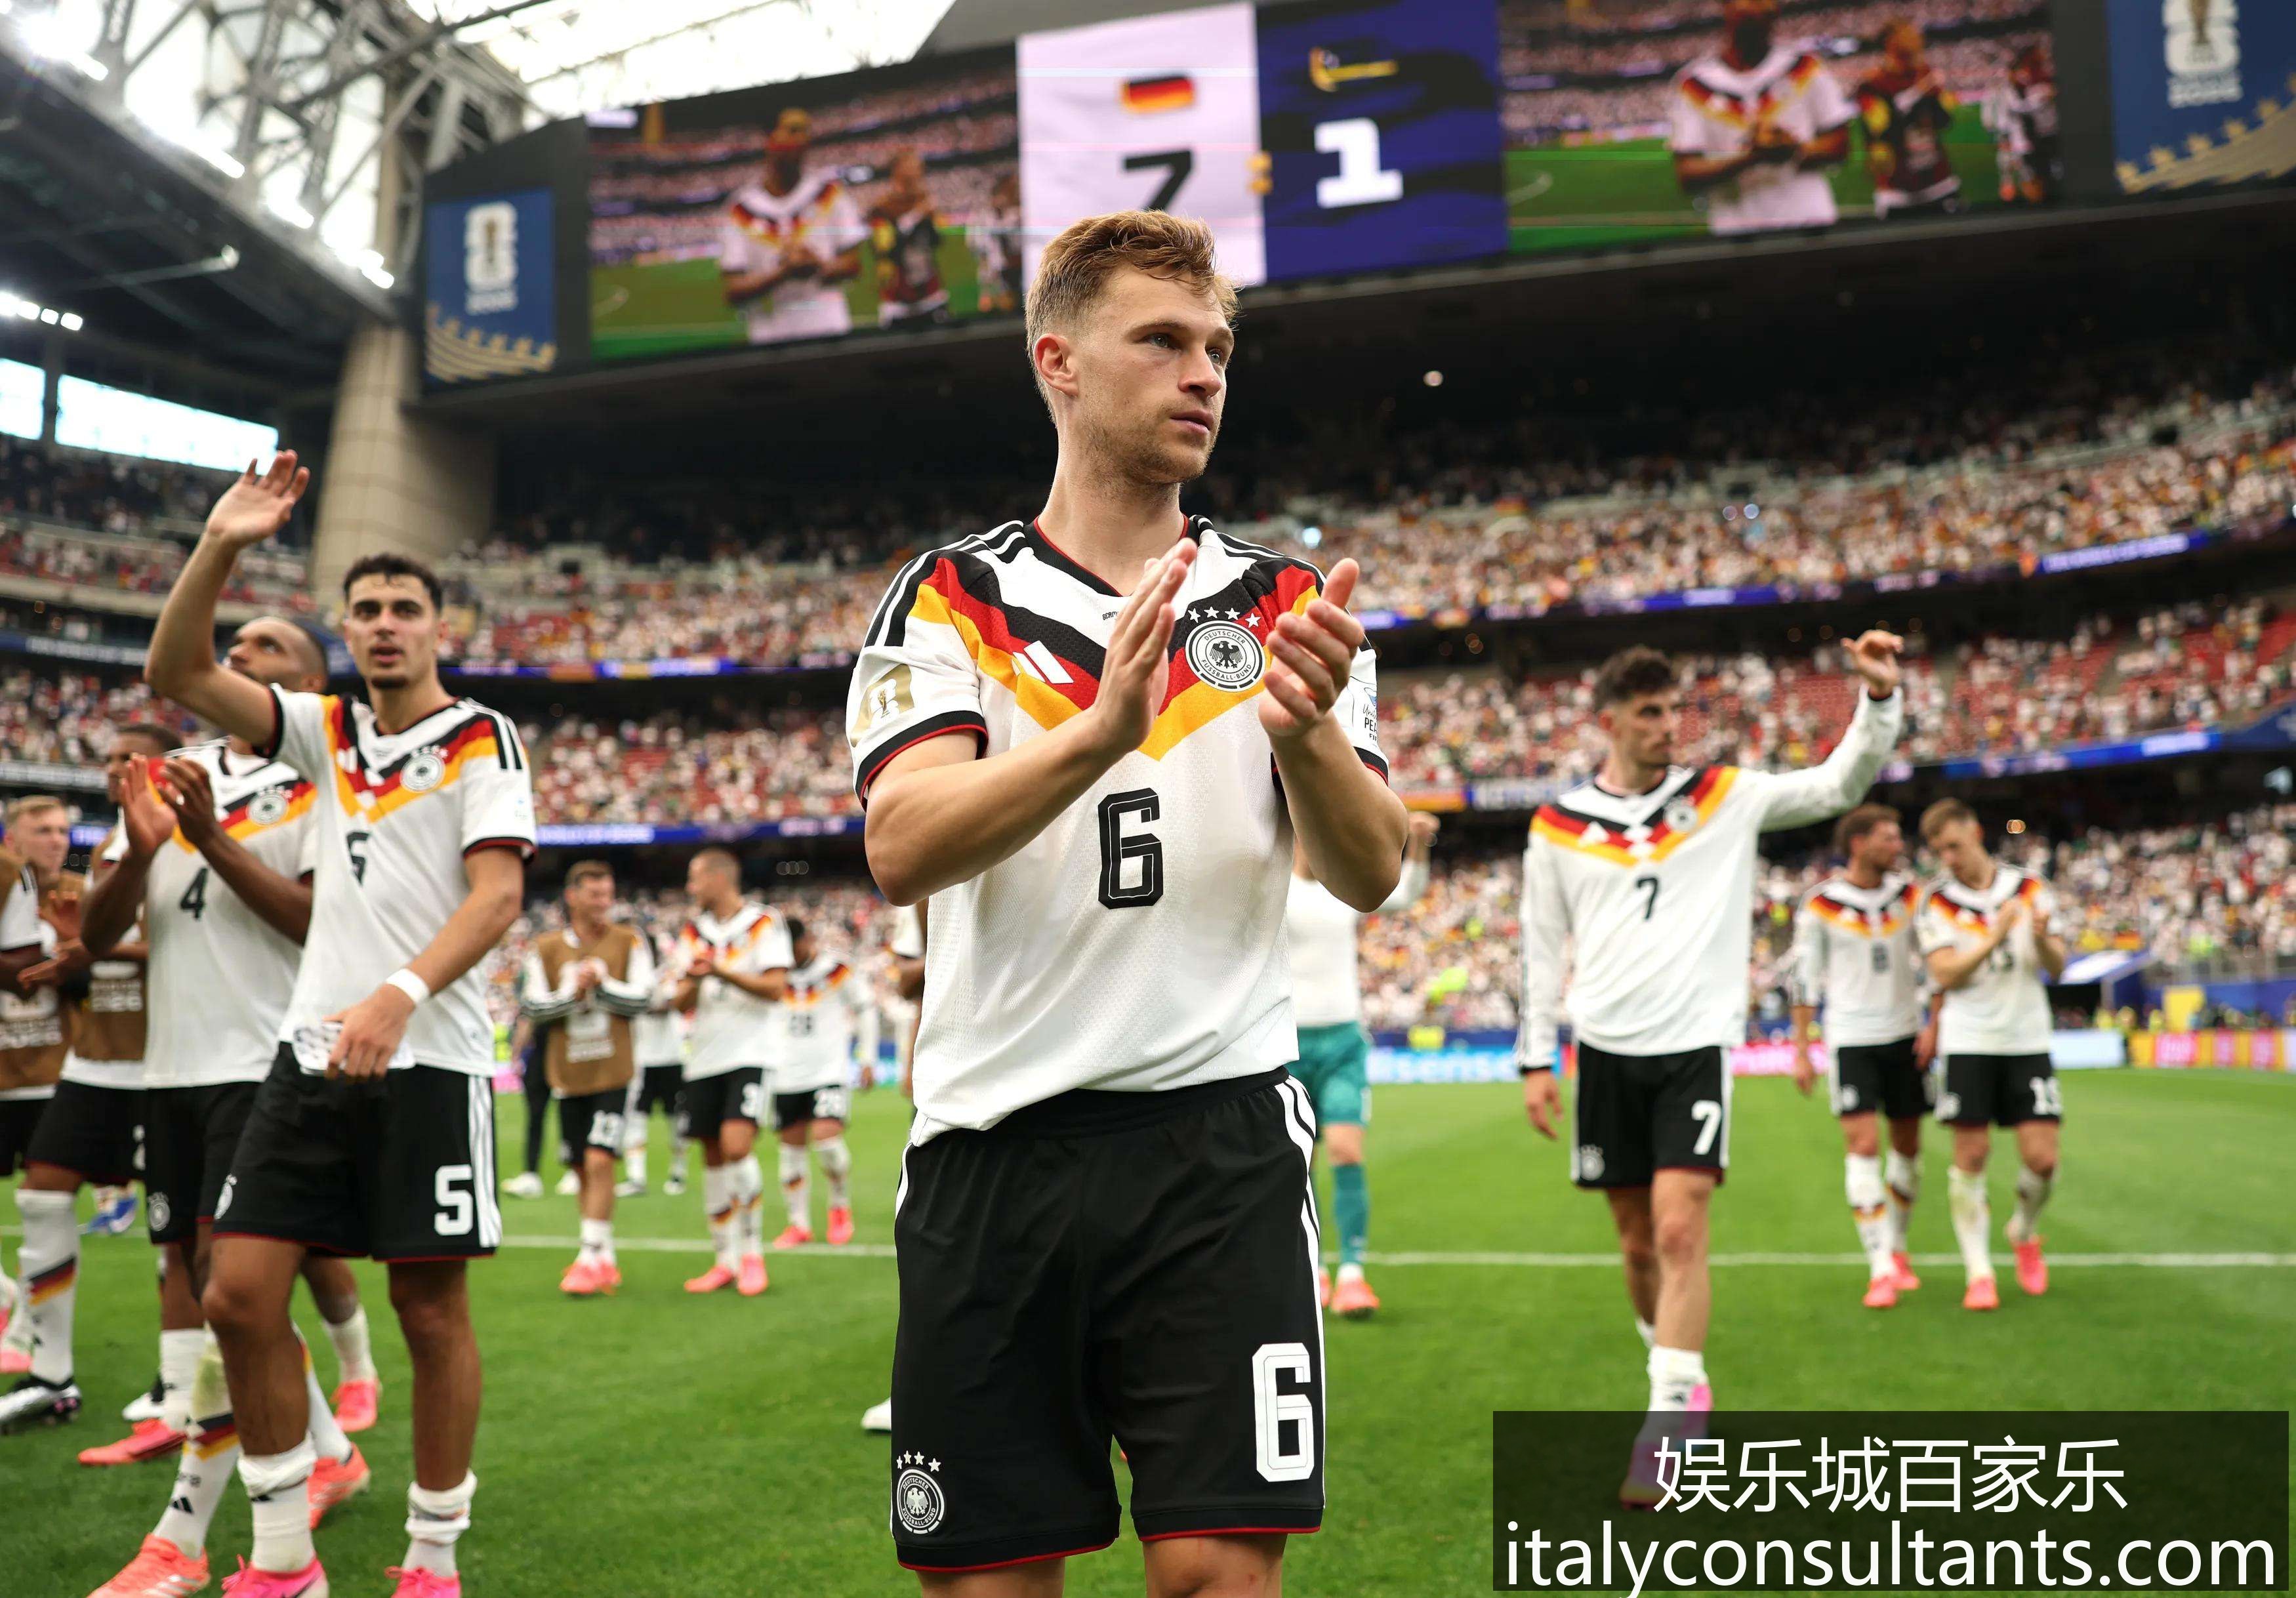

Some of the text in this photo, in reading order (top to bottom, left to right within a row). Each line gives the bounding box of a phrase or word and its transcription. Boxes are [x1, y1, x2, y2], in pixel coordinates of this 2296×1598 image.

[1123, 150, 1194, 211] 7
[1315, 117, 1403, 209] 1
[1204, 630, 1246, 644] DEUTSCHER
[1201, 659, 1252, 680] FUSSBALL-BUND
[1097, 787, 1164, 910] 6
[180, 867, 209, 920] 4
[1635, 876, 1660, 920] 7
[1691, 1099, 1722, 1155] 7
[434, 1164, 474, 1235] 5
[1252, 1342, 1315, 1483] 6
[902, 1477, 929, 1490] DEUTSCHER
[902, 1507, 936, 1526] FUSSBALL-BUND
